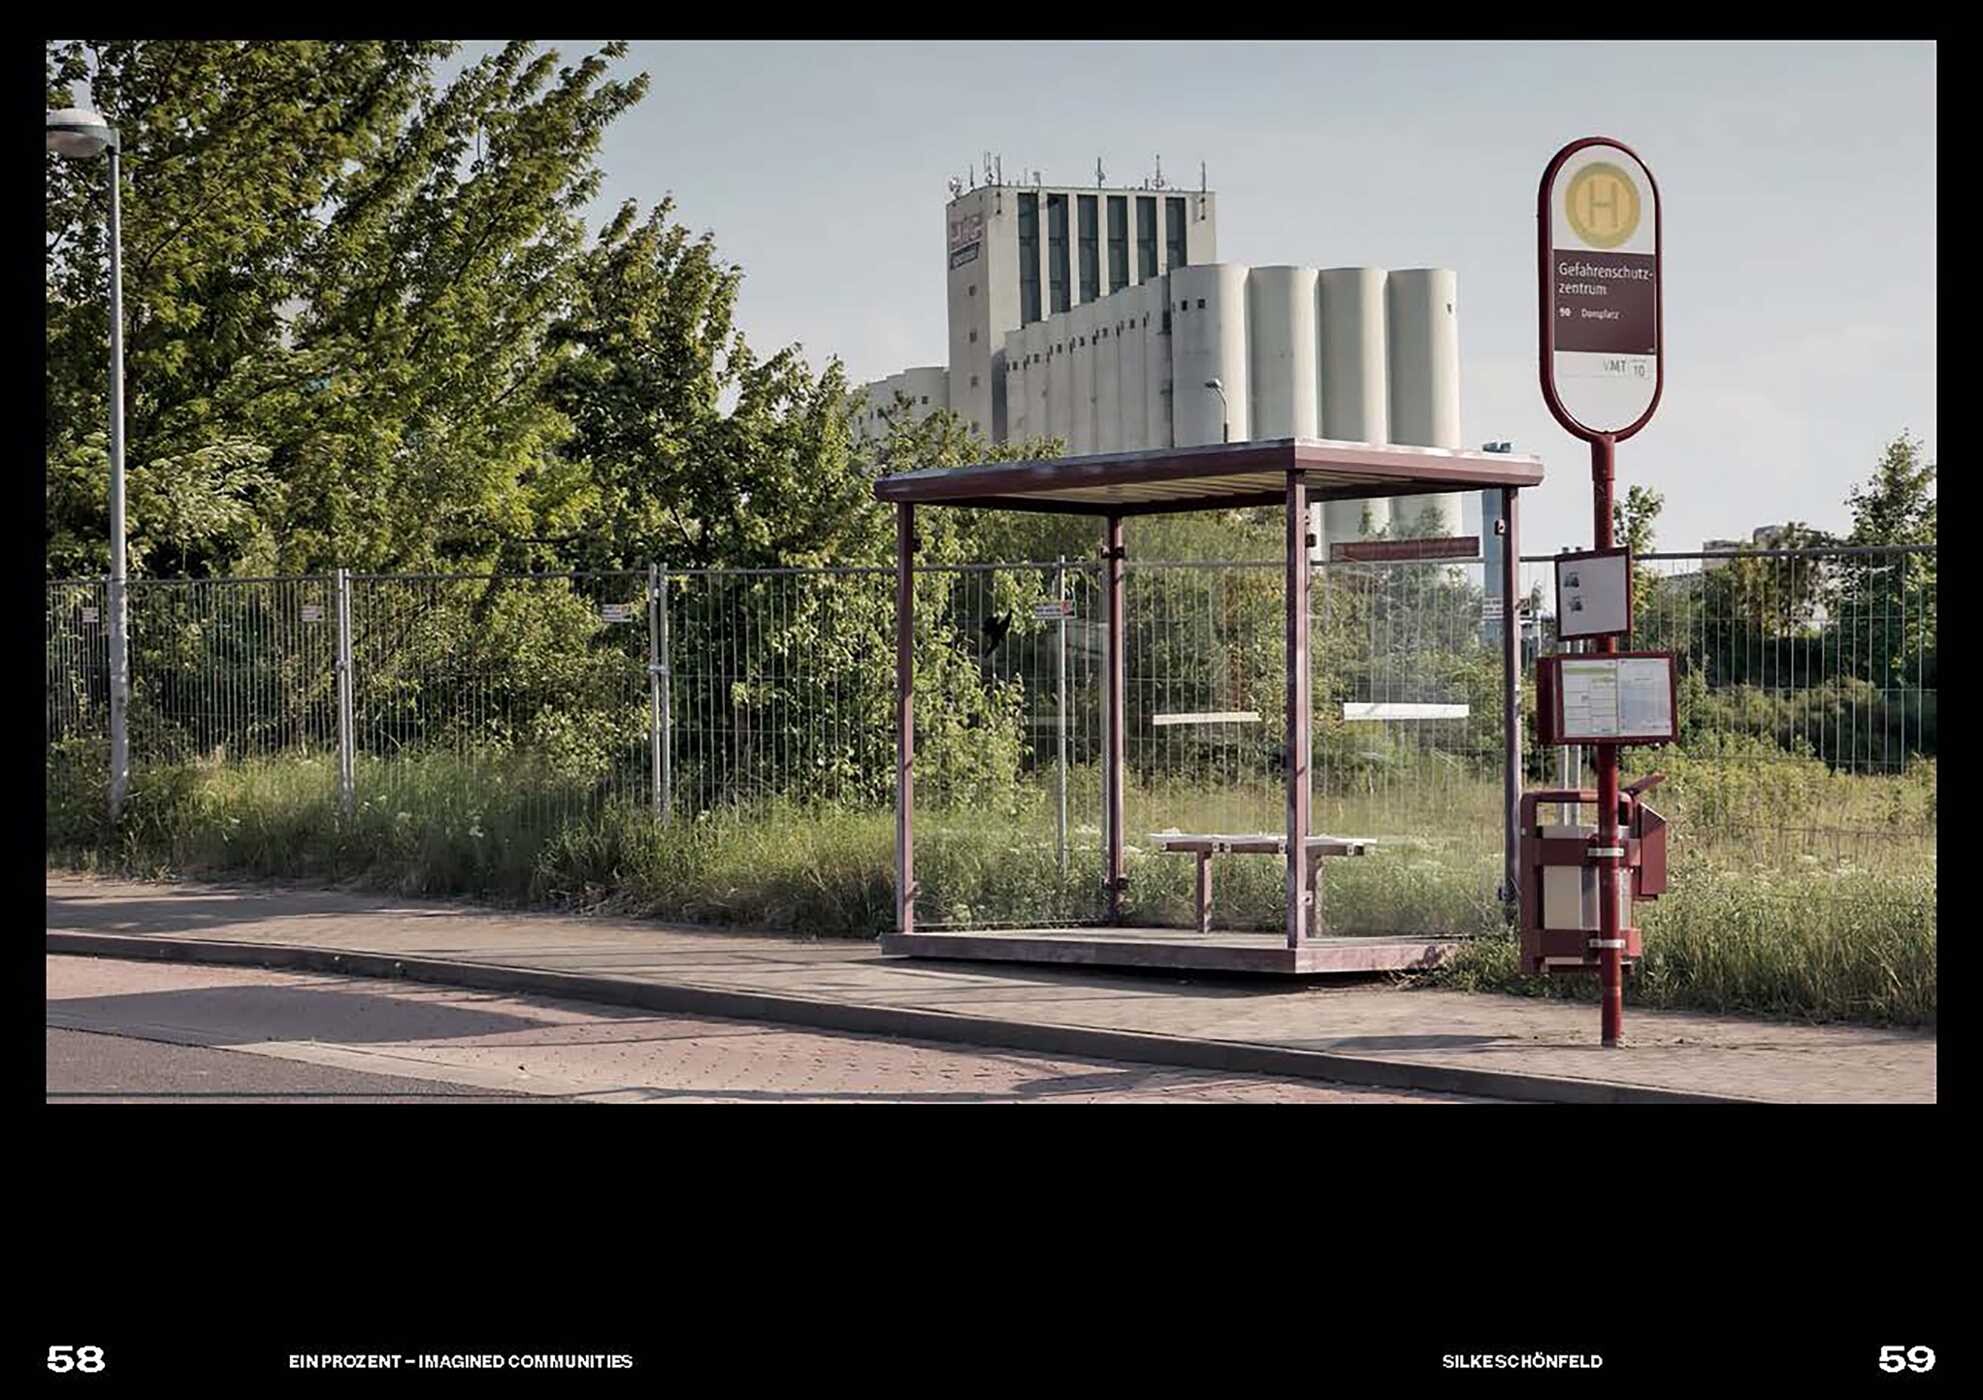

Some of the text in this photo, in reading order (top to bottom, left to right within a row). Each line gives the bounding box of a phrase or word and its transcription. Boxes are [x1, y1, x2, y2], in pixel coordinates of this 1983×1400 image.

[1590, 181, 1618, 228] H
[1559, 262, 1653, 280] Gefahrenschutz-
[1559, 282, 1607, 296] zentrum
